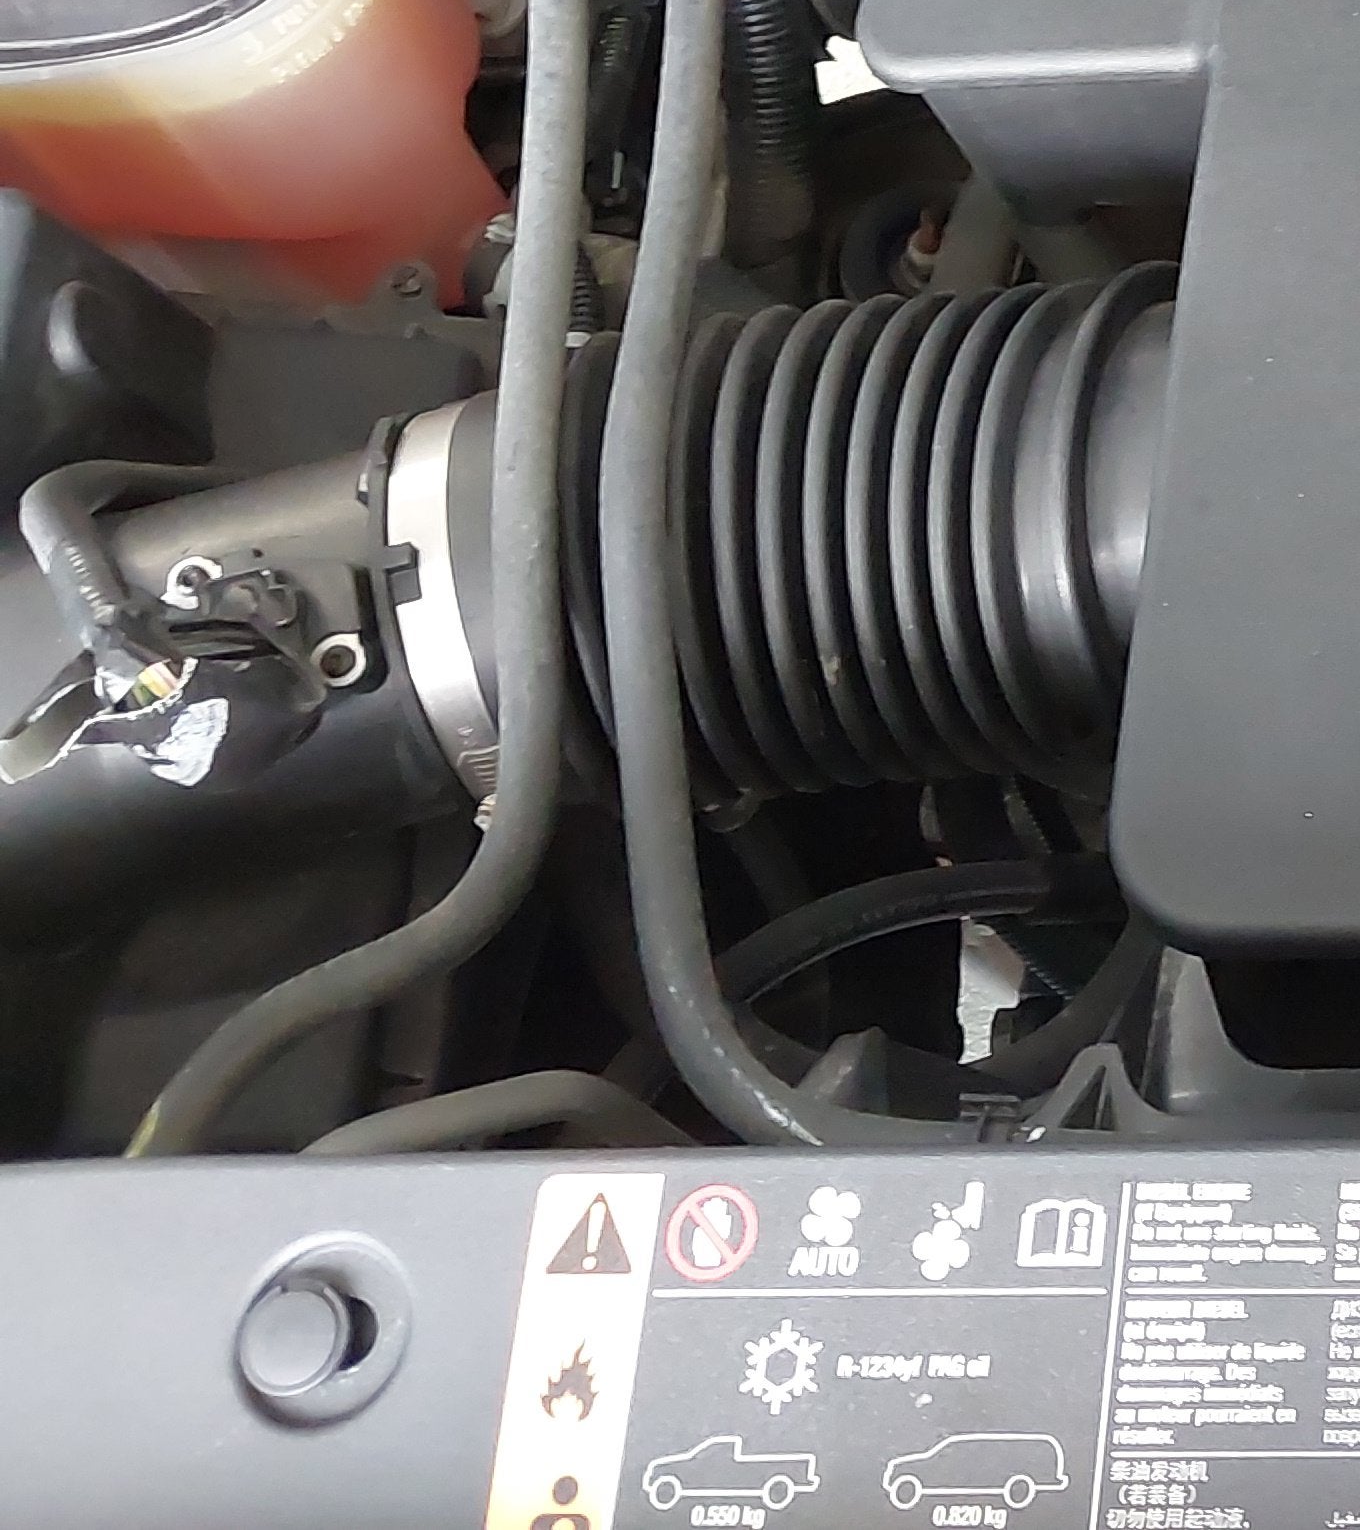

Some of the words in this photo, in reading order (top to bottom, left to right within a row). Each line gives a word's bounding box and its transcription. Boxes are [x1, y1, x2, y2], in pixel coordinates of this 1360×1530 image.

[786, 1246, 860, 1278] AUTO
[690, 1505, 740, 1527] 0.550
[741, 1505, 766, 1529] kg
[932, 1505, 982, 1527] 0.820
[983, 1505, 1008, 1529] kg
